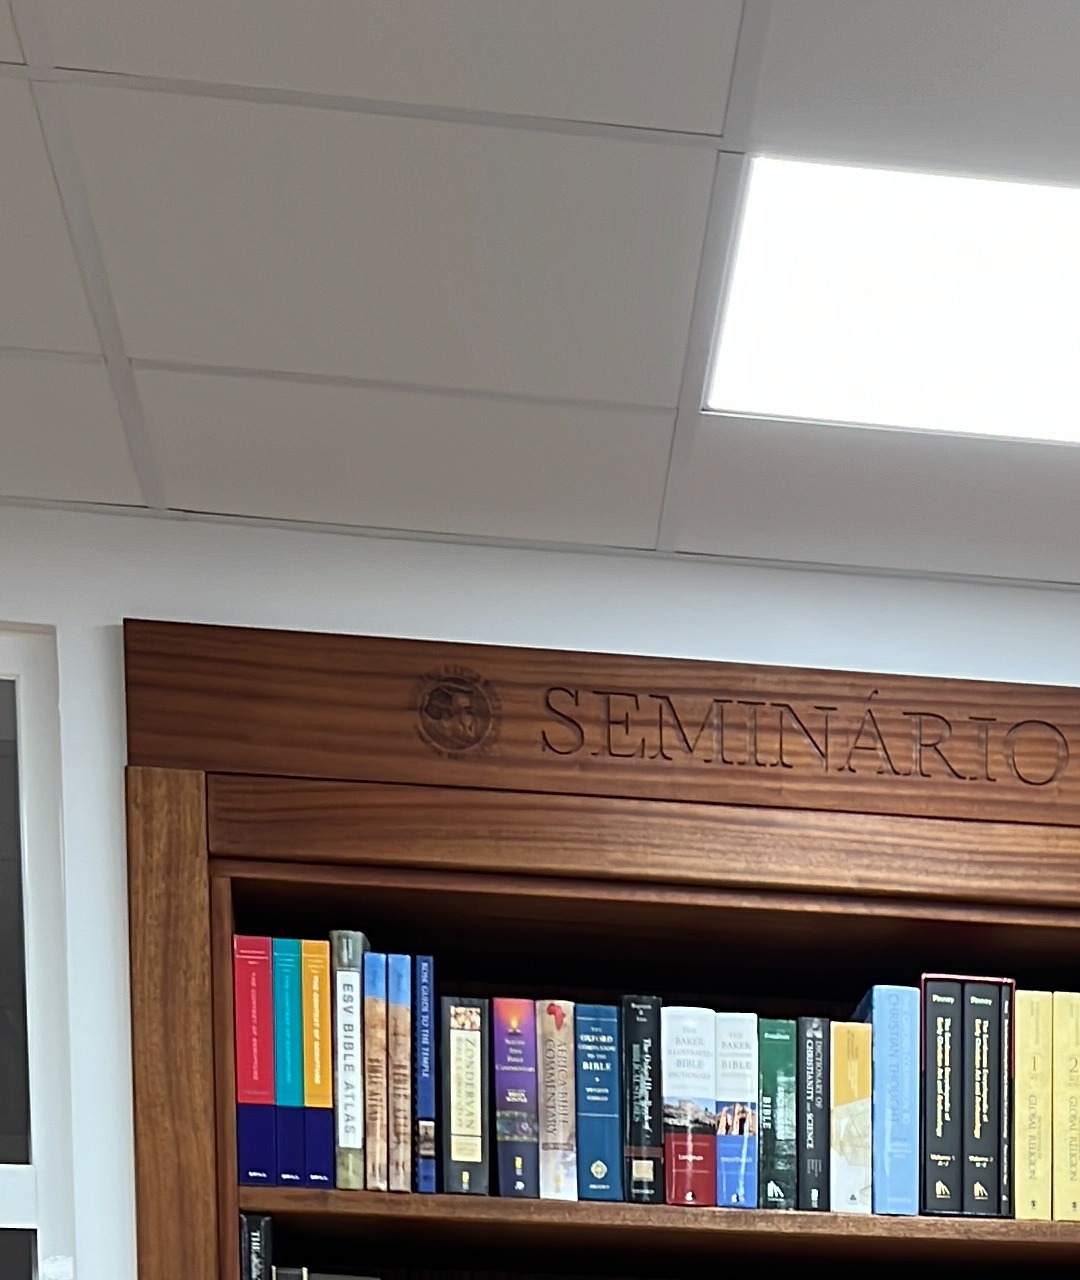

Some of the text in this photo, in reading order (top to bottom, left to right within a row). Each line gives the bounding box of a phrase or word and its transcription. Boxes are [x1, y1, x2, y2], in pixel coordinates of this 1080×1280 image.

[540, 688, 1071, 786] SEMINÁRIO
[342, 983, 355, 1134] ESV BIBLE ATLAS
[556, 1038, 569, 1125] AFRICA BIBLE
[580, 1034, 613, 1043] OXFORD
[583, 1062, 611, 1070] BIBLE
[806, 1039, 814, 1100] CHRISTIANITY
[464, 1038, 476, 1128] ZONDERVAN
[544, 1039, 557, 1137] COMMENTARY
[763, 1097, 771, 1129] BIBLE
